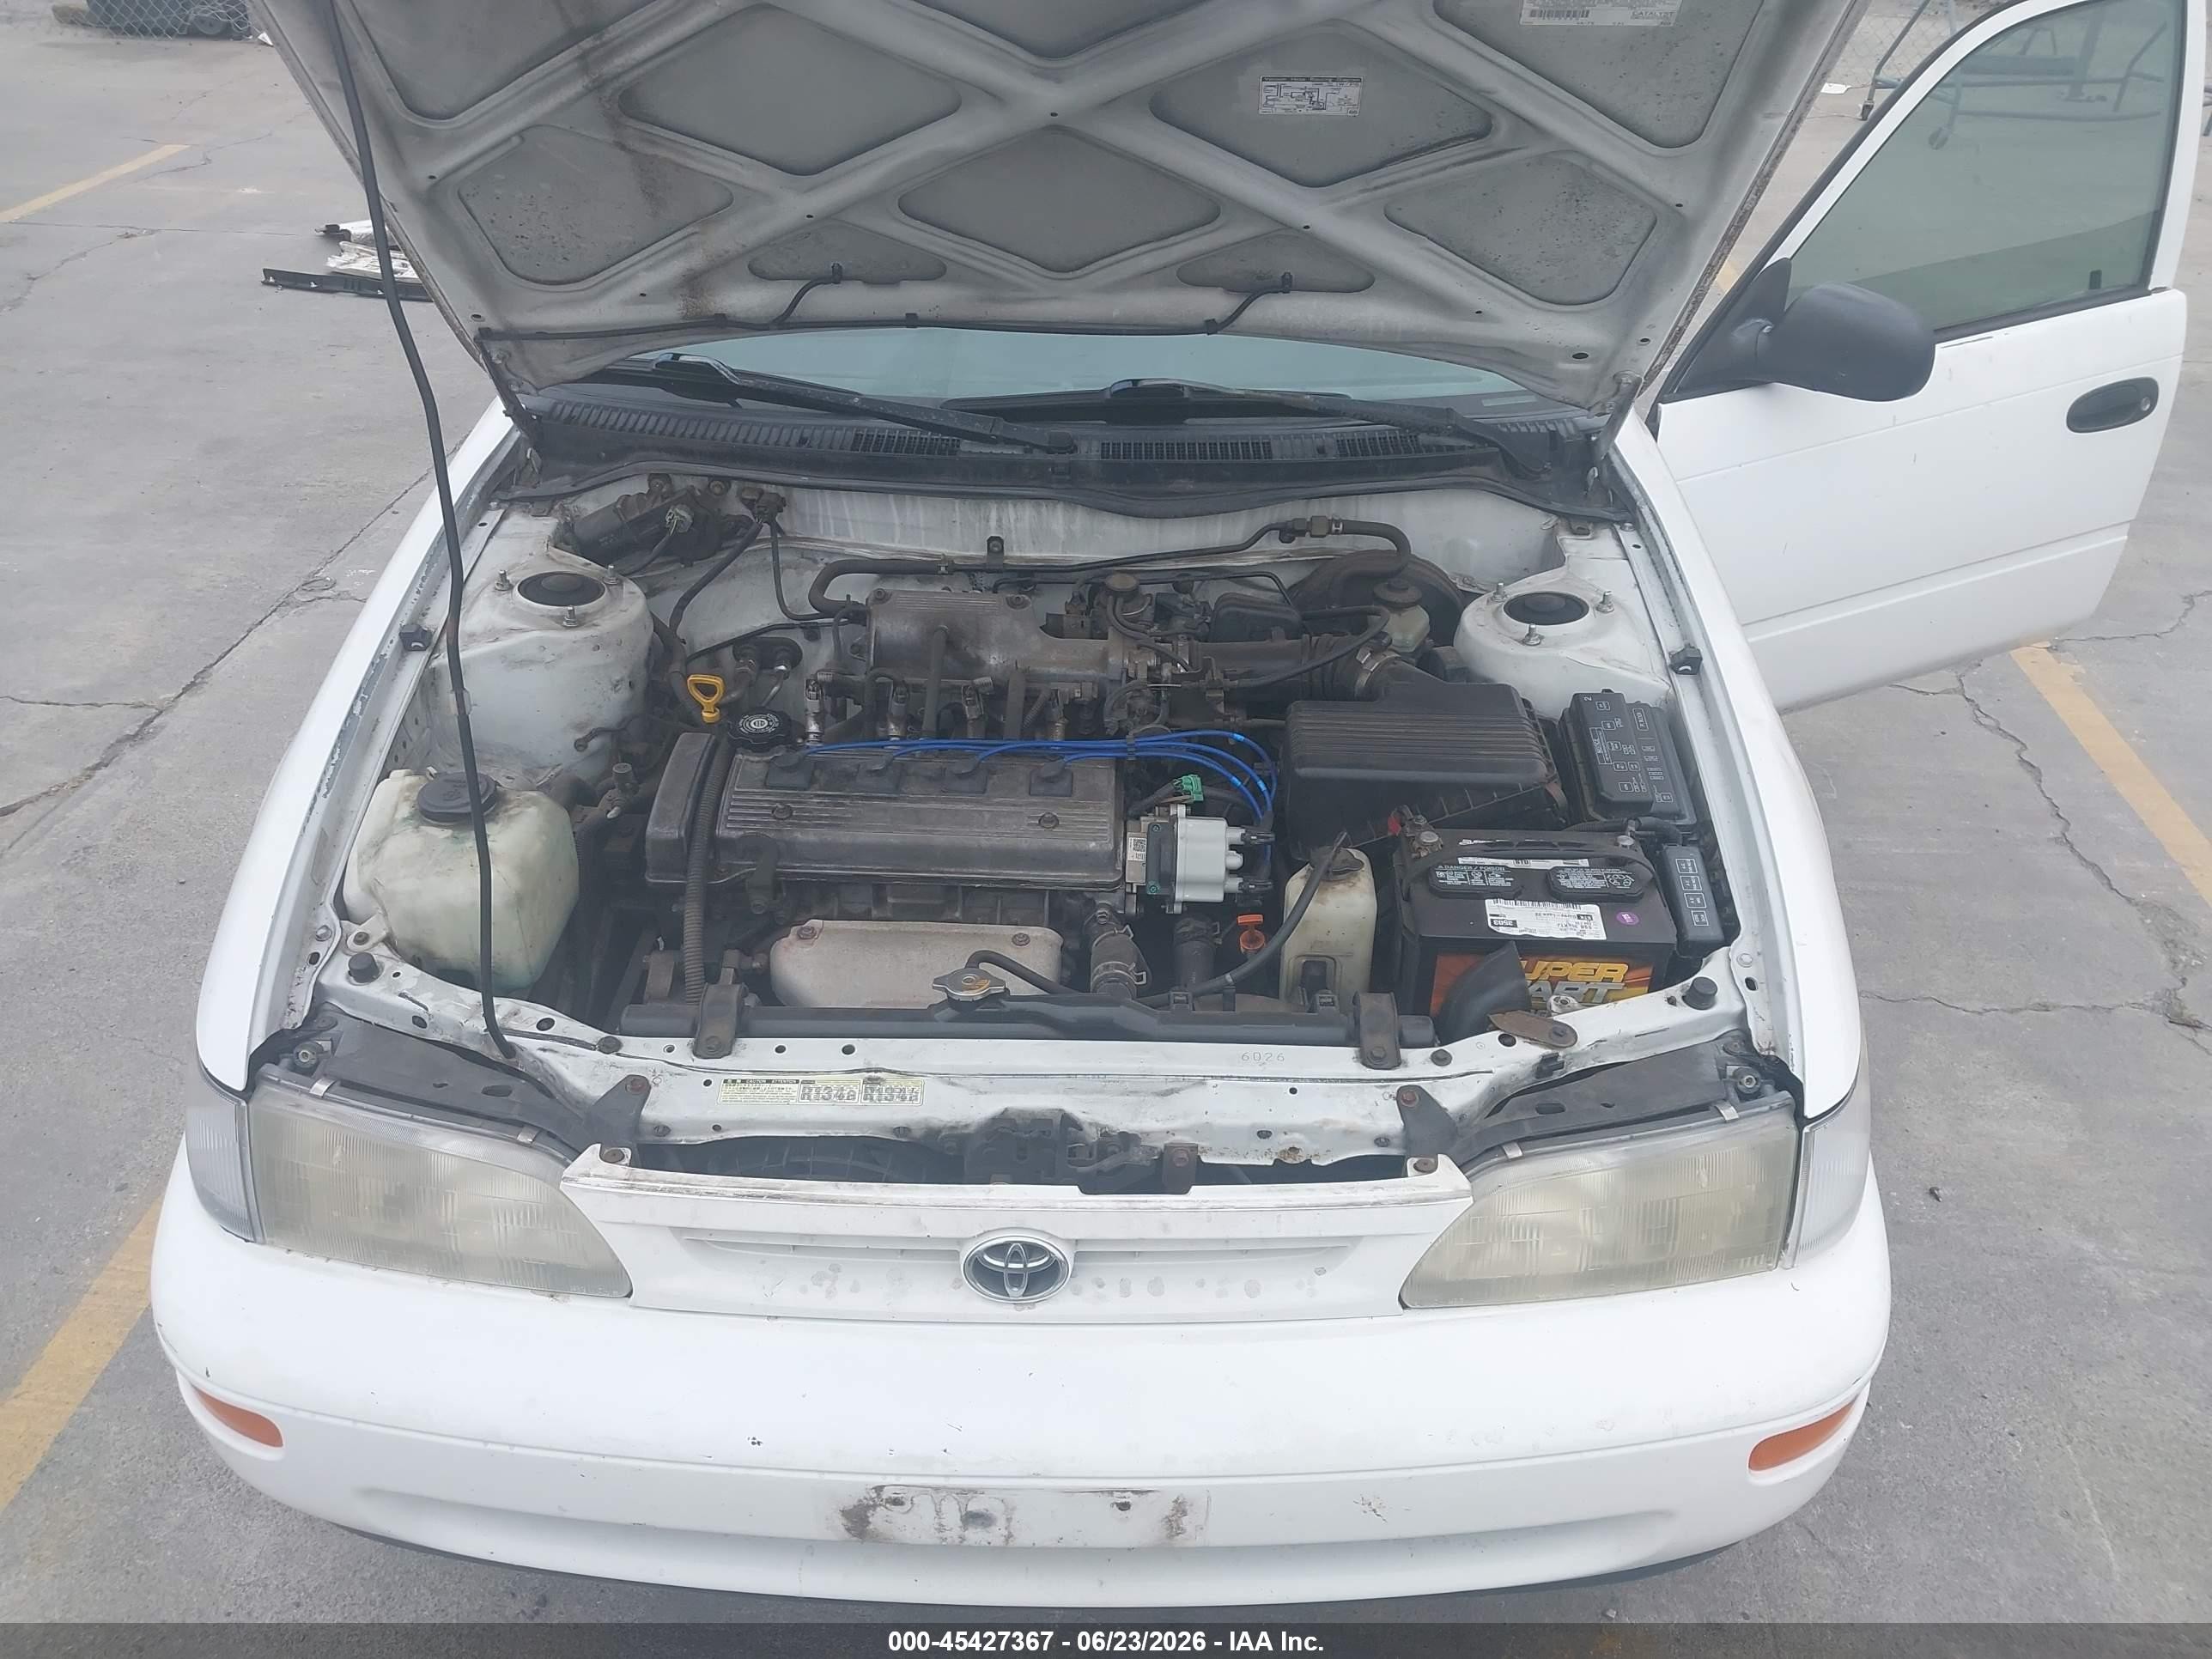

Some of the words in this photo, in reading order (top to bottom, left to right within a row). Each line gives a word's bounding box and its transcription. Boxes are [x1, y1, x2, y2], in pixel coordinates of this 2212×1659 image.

[1520, 960, 1629, 982] UPER
[1527, 981, 1626, 1004] ART
[1242, 1052, 1285, 1062] 6026
